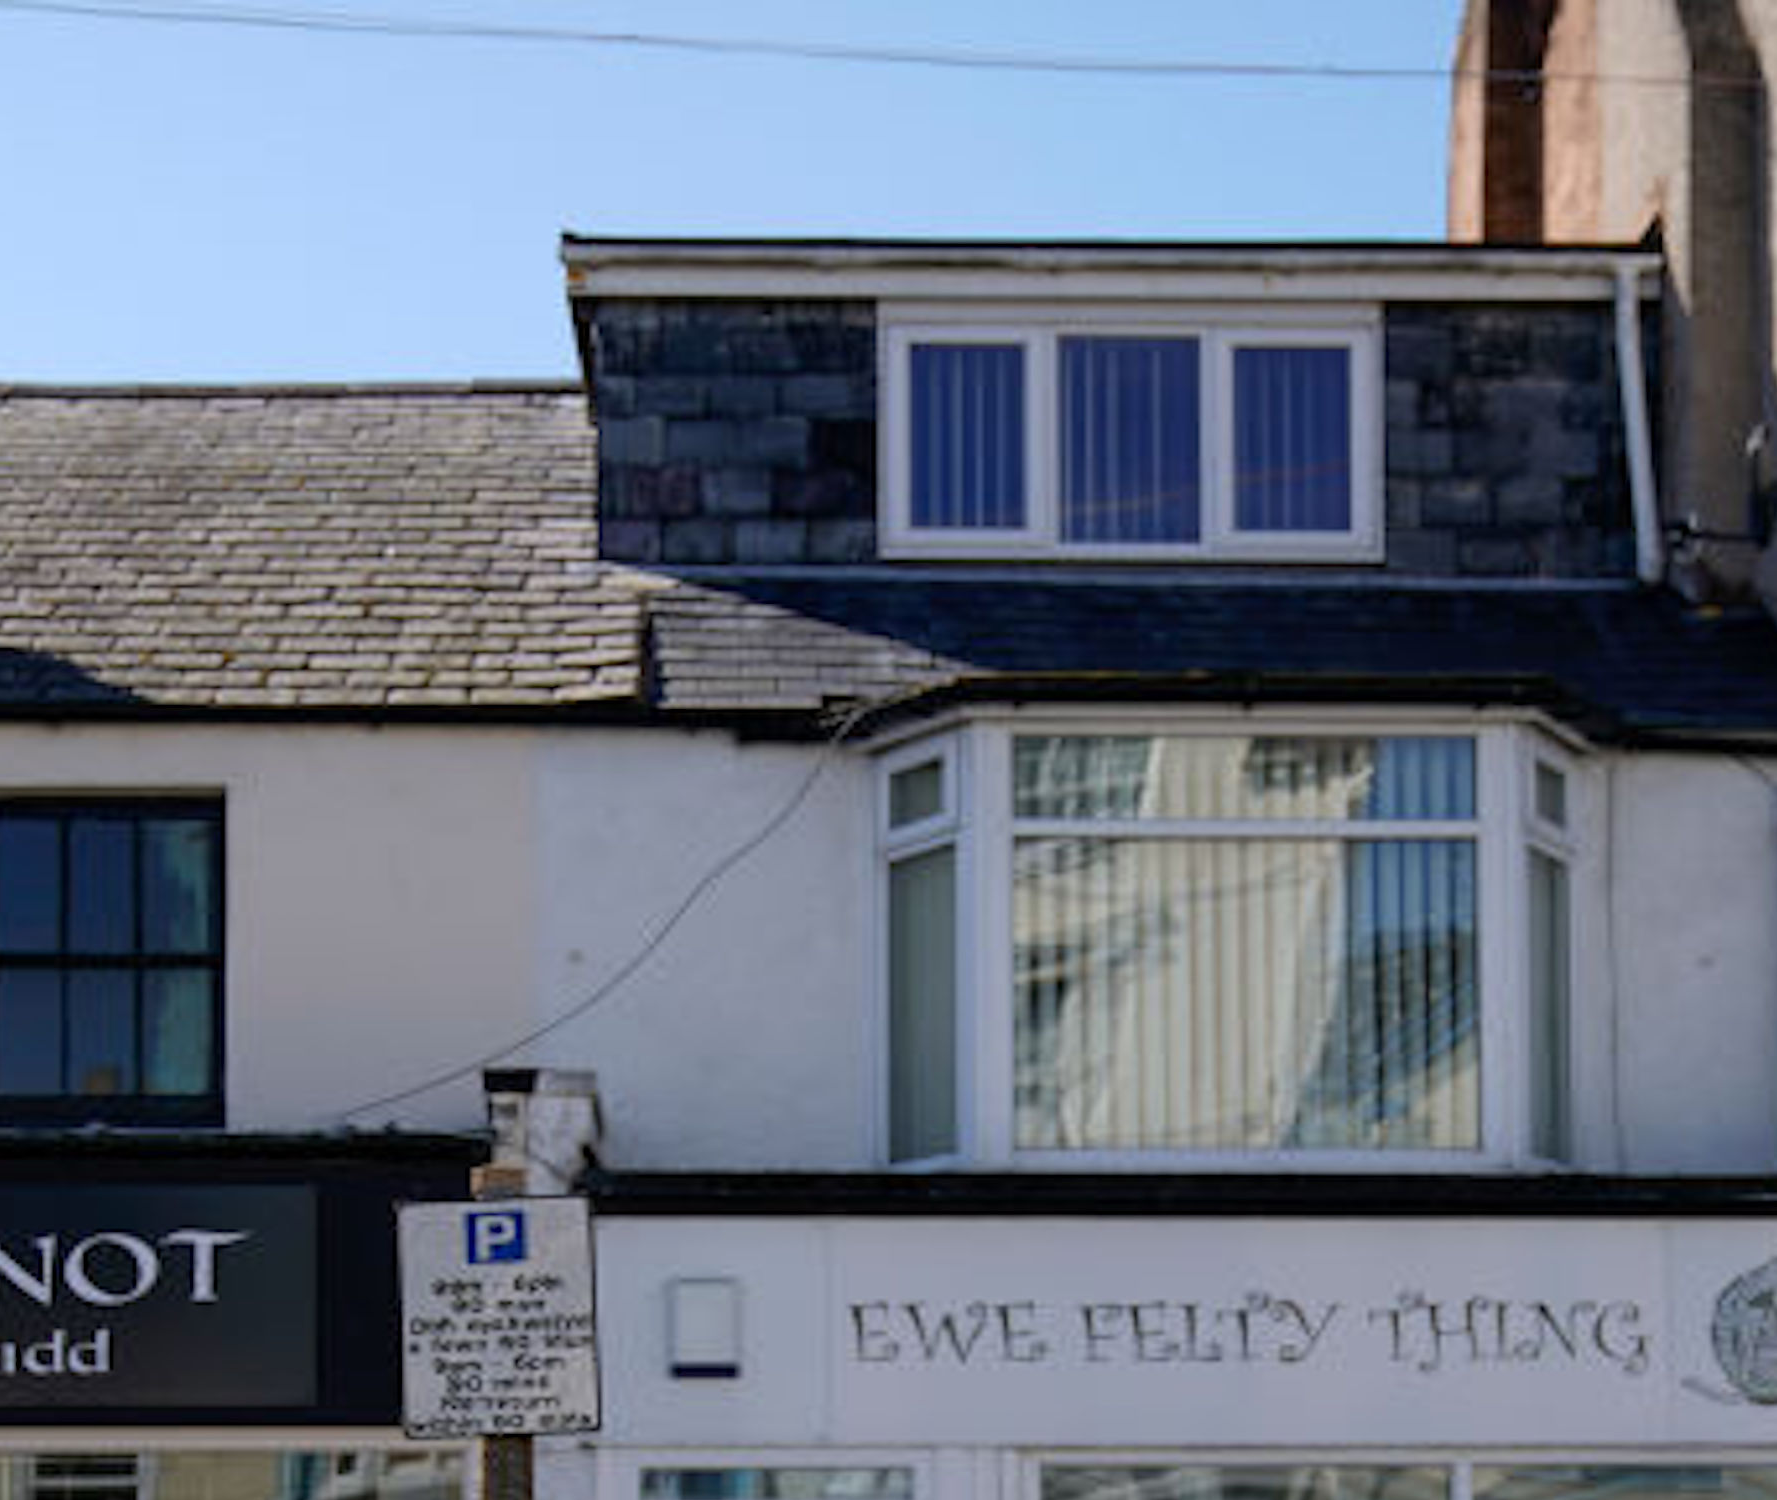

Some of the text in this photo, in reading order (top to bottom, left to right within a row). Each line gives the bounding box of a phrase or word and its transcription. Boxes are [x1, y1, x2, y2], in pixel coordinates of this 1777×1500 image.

[474, 1215, 518, 1260] P
[847, 1291, 1650, 1374] EWE FELTY THING
